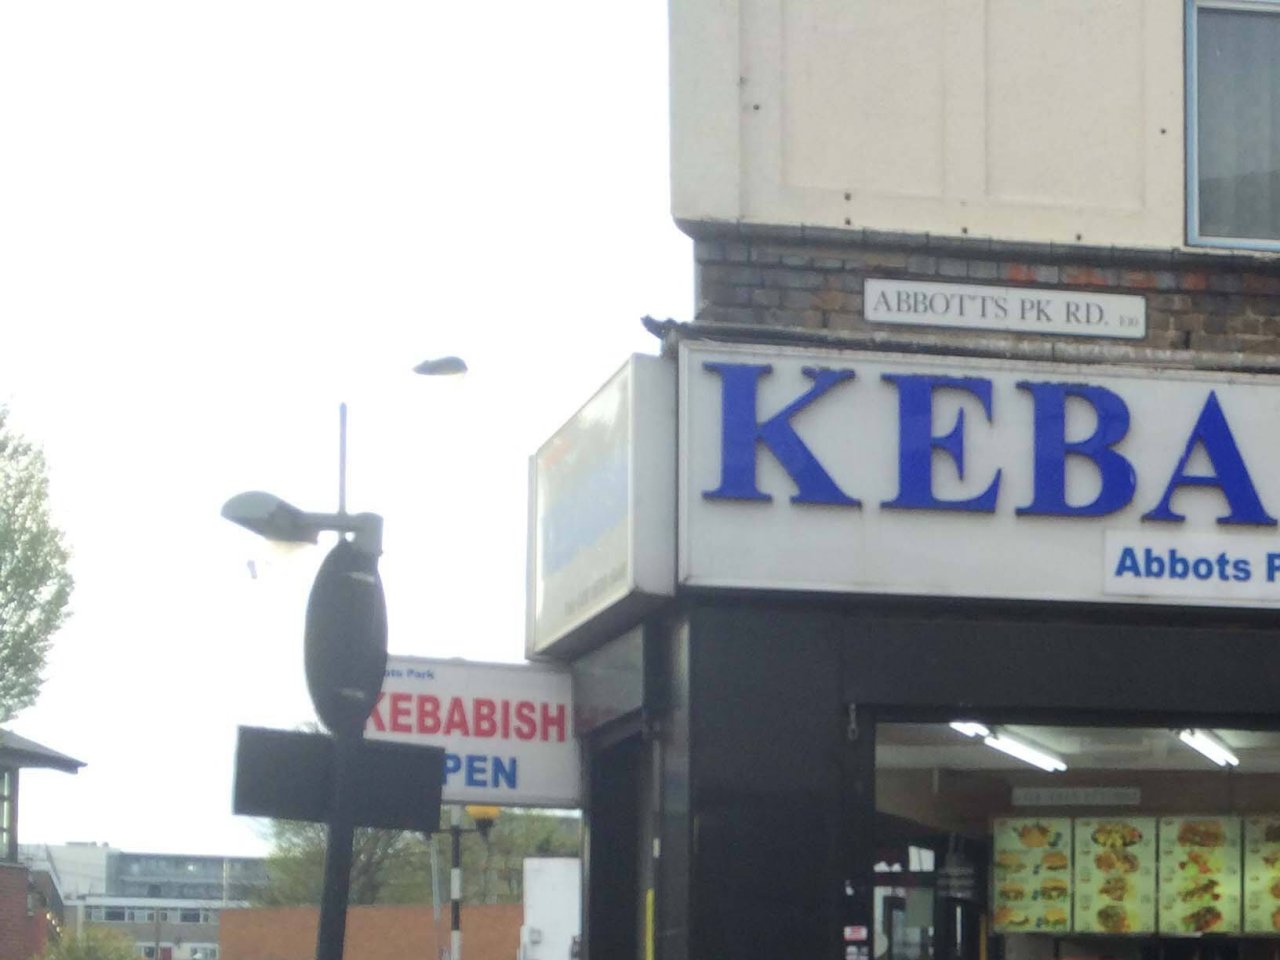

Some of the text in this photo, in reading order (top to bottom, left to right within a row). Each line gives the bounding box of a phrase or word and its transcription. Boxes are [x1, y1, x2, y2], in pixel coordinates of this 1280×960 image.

[873, 290, 1008, 319] ABBOTTS
[1020, 298, 1052, 322] PK
[1065, 302, 1109, 326] RD.
[1115, 547, 1252, 581] Abbots
[443, 752, 517, 789] PEN
